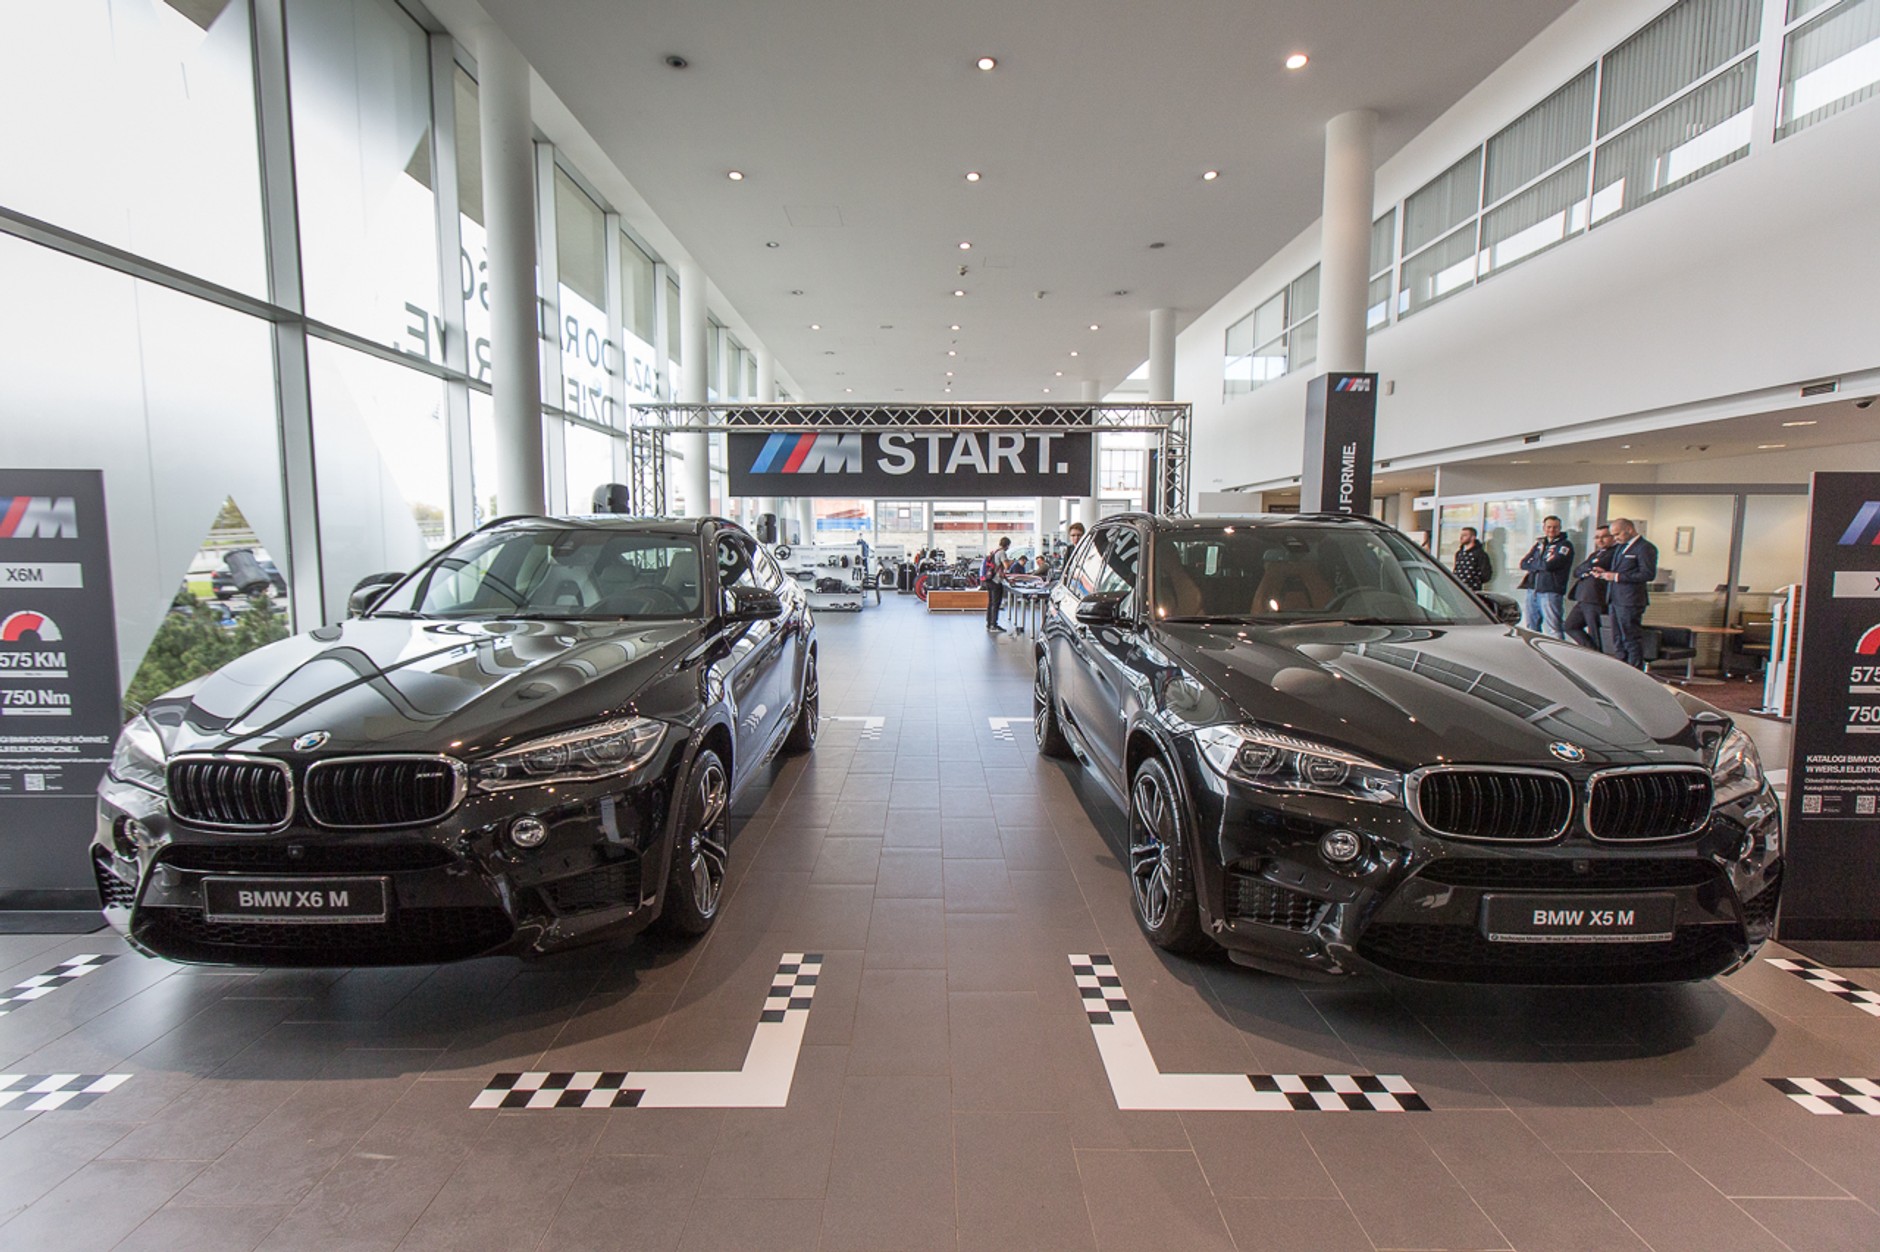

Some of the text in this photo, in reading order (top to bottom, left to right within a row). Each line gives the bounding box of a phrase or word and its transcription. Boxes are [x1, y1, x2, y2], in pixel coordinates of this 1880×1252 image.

[877, 431, 1069, 475] START.
[1339, 442, 1357, 502] FORMIE.
[6, 568, 43, 582] X6M
[0, 652, 67, 668] 575 KM
[1, 689, 71, 705] 750 Nm
[1806, 755, 1846, 763] KATALOGI
[1847, 755, 1868, 763] BMW
[1815, 765, 1845, 773] WERSJI
[239, 891, 349, 907] BMW X6 M
[1533, 910, 1635, 925] BMW X5 M
